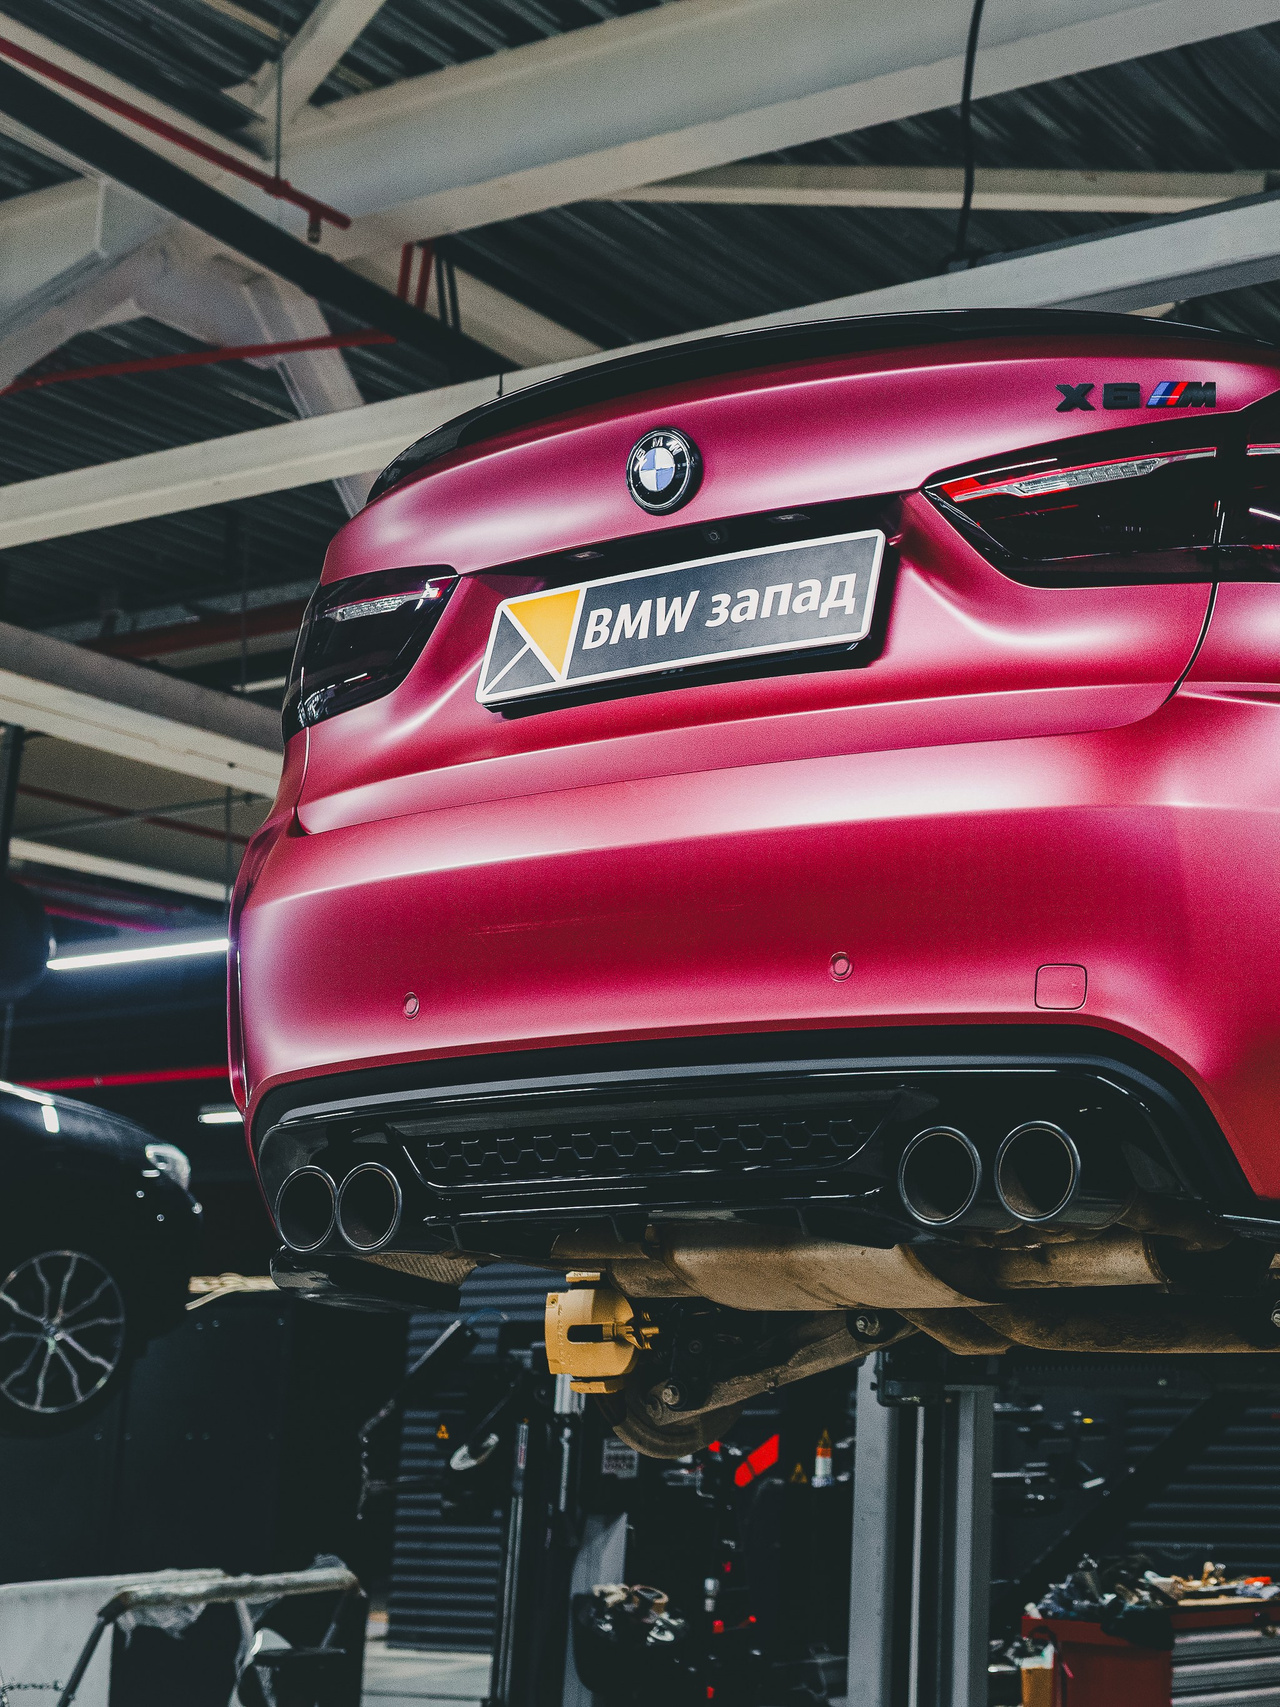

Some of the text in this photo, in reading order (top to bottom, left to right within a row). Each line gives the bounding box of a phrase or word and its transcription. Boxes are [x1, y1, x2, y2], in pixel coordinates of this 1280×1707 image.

[633, 436, 683, 472] BMW
[582, 572, 857, 650] BMW запад
